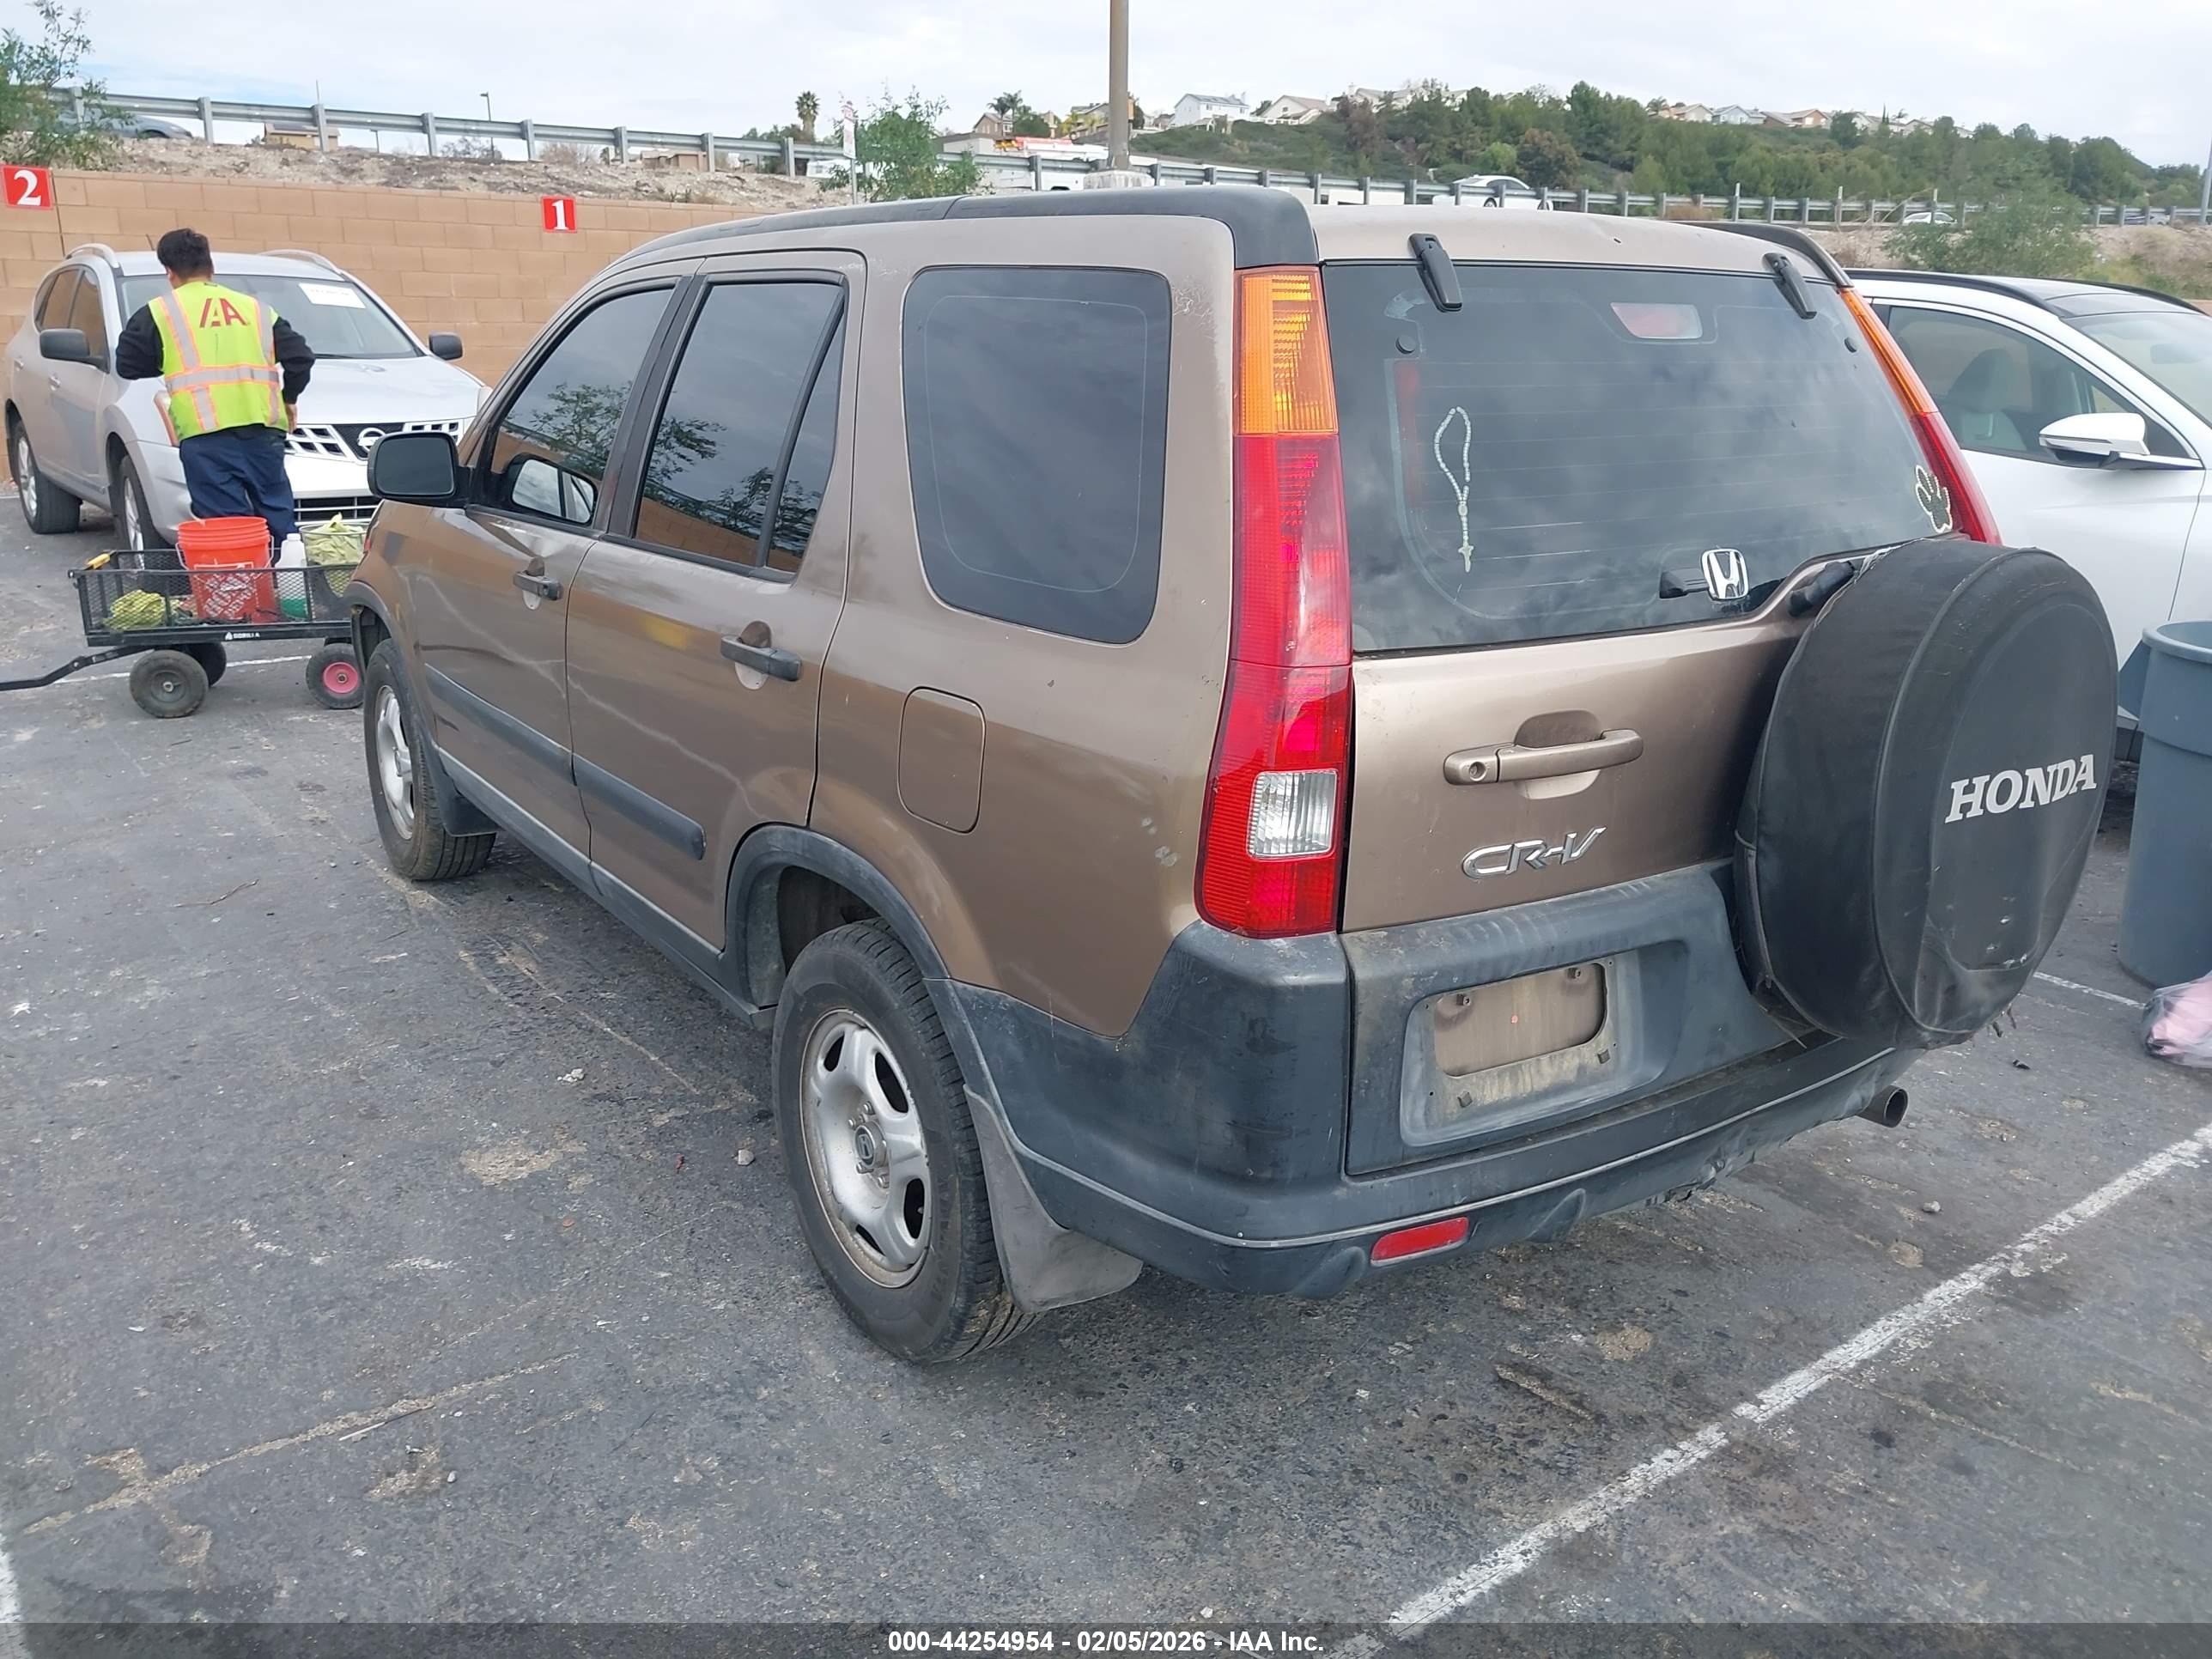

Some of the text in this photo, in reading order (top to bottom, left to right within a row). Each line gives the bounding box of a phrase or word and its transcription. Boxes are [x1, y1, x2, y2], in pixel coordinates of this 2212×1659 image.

[14, 169, 41, 206] 2
[551, 199, 569, 230] 1
[1944, 754, 2097, 823] HONDA
[1462, 827, 1607, 878] CR-V
